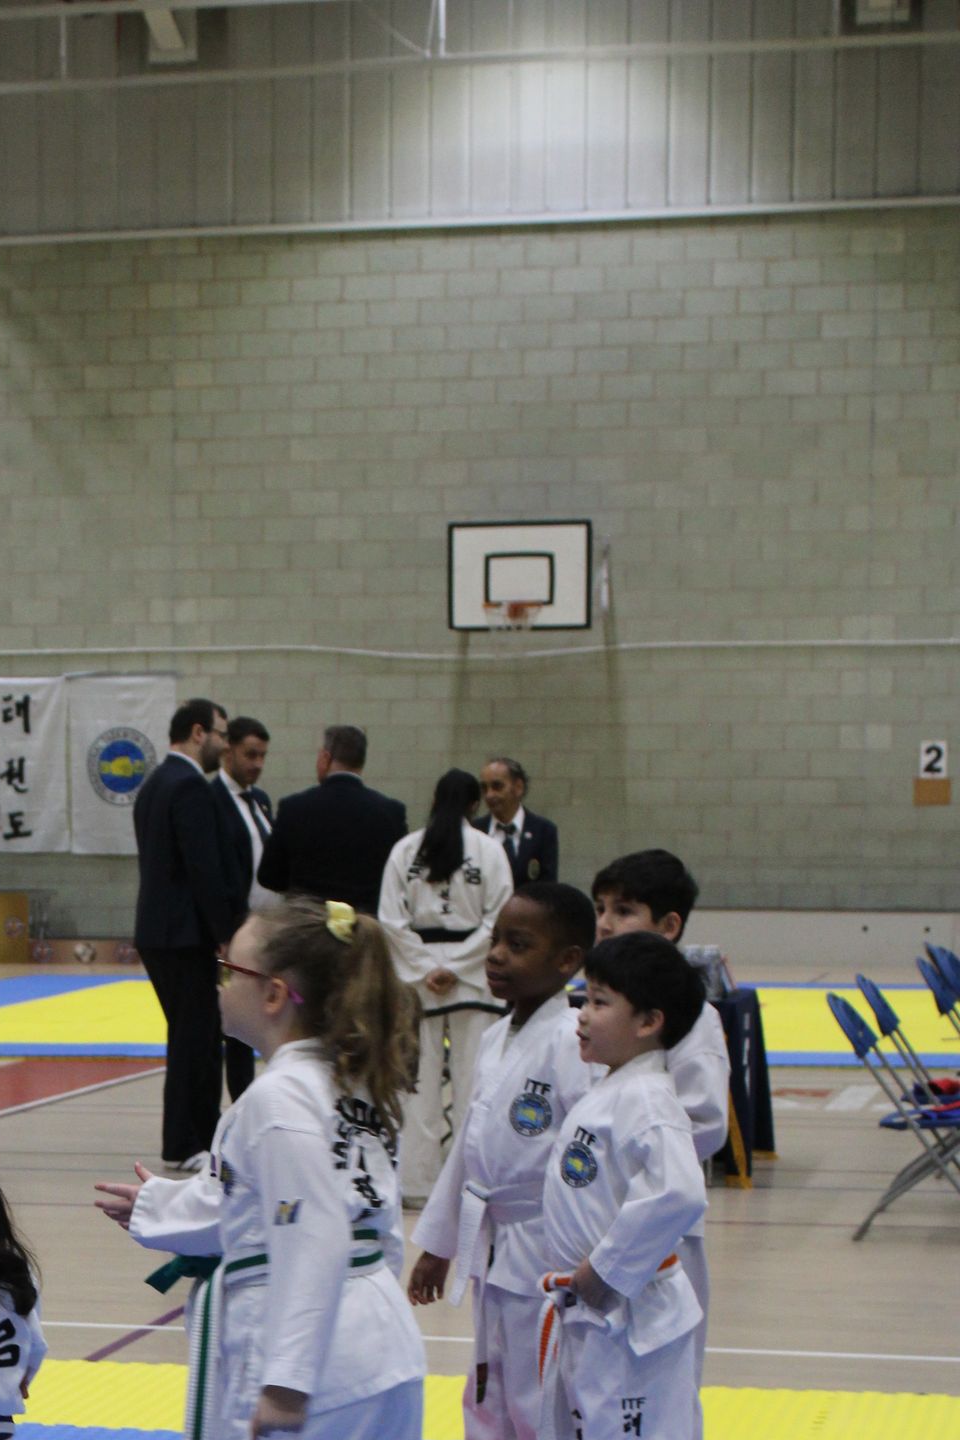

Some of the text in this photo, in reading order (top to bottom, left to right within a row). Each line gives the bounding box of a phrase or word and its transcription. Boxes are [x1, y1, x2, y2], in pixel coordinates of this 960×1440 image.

[923, 745, 943, 773] 2
[524, 1078, 551, 1095] ITF
[574, 1125, 597, 1145] ITF
[622, 1397, 646, 1410] ITF
